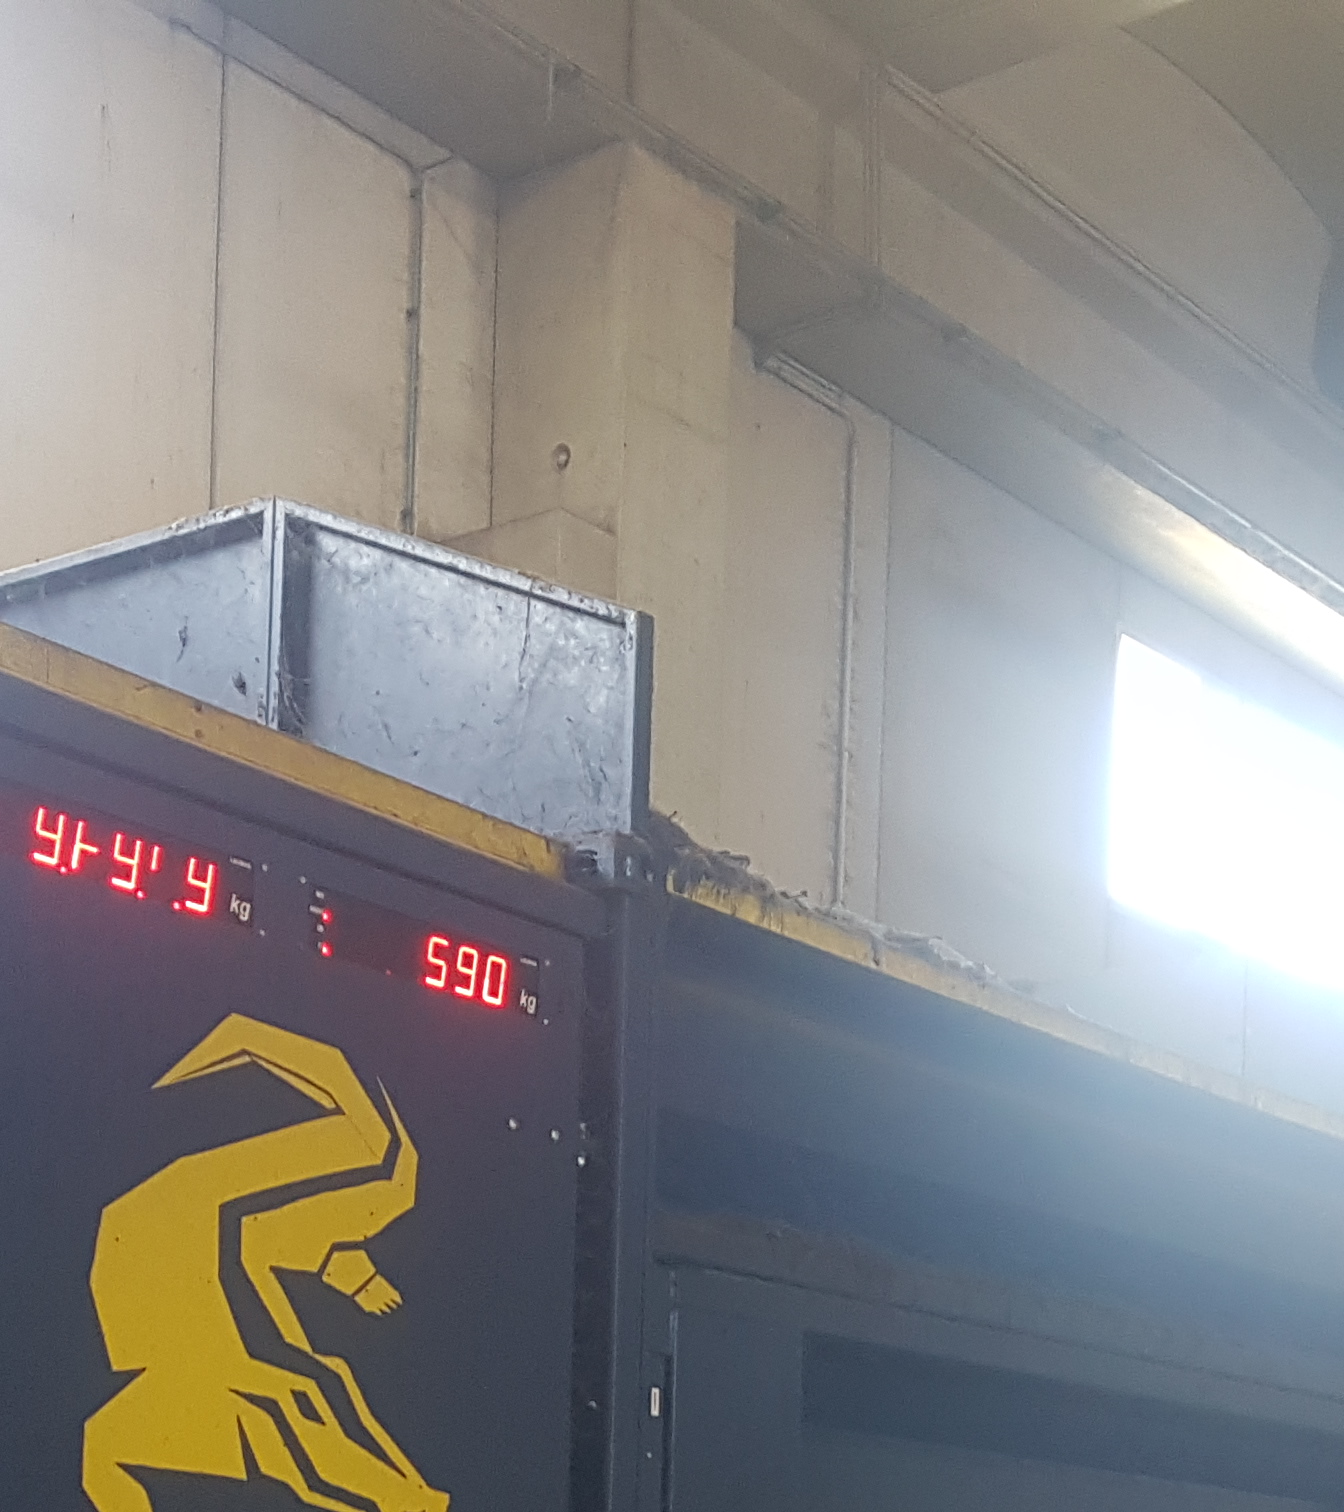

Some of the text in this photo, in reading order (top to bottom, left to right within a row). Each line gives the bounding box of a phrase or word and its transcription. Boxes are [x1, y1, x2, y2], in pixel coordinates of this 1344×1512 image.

[230, 893, 251, 921] kg
[425, 936, 536, 1014] 590 kg
